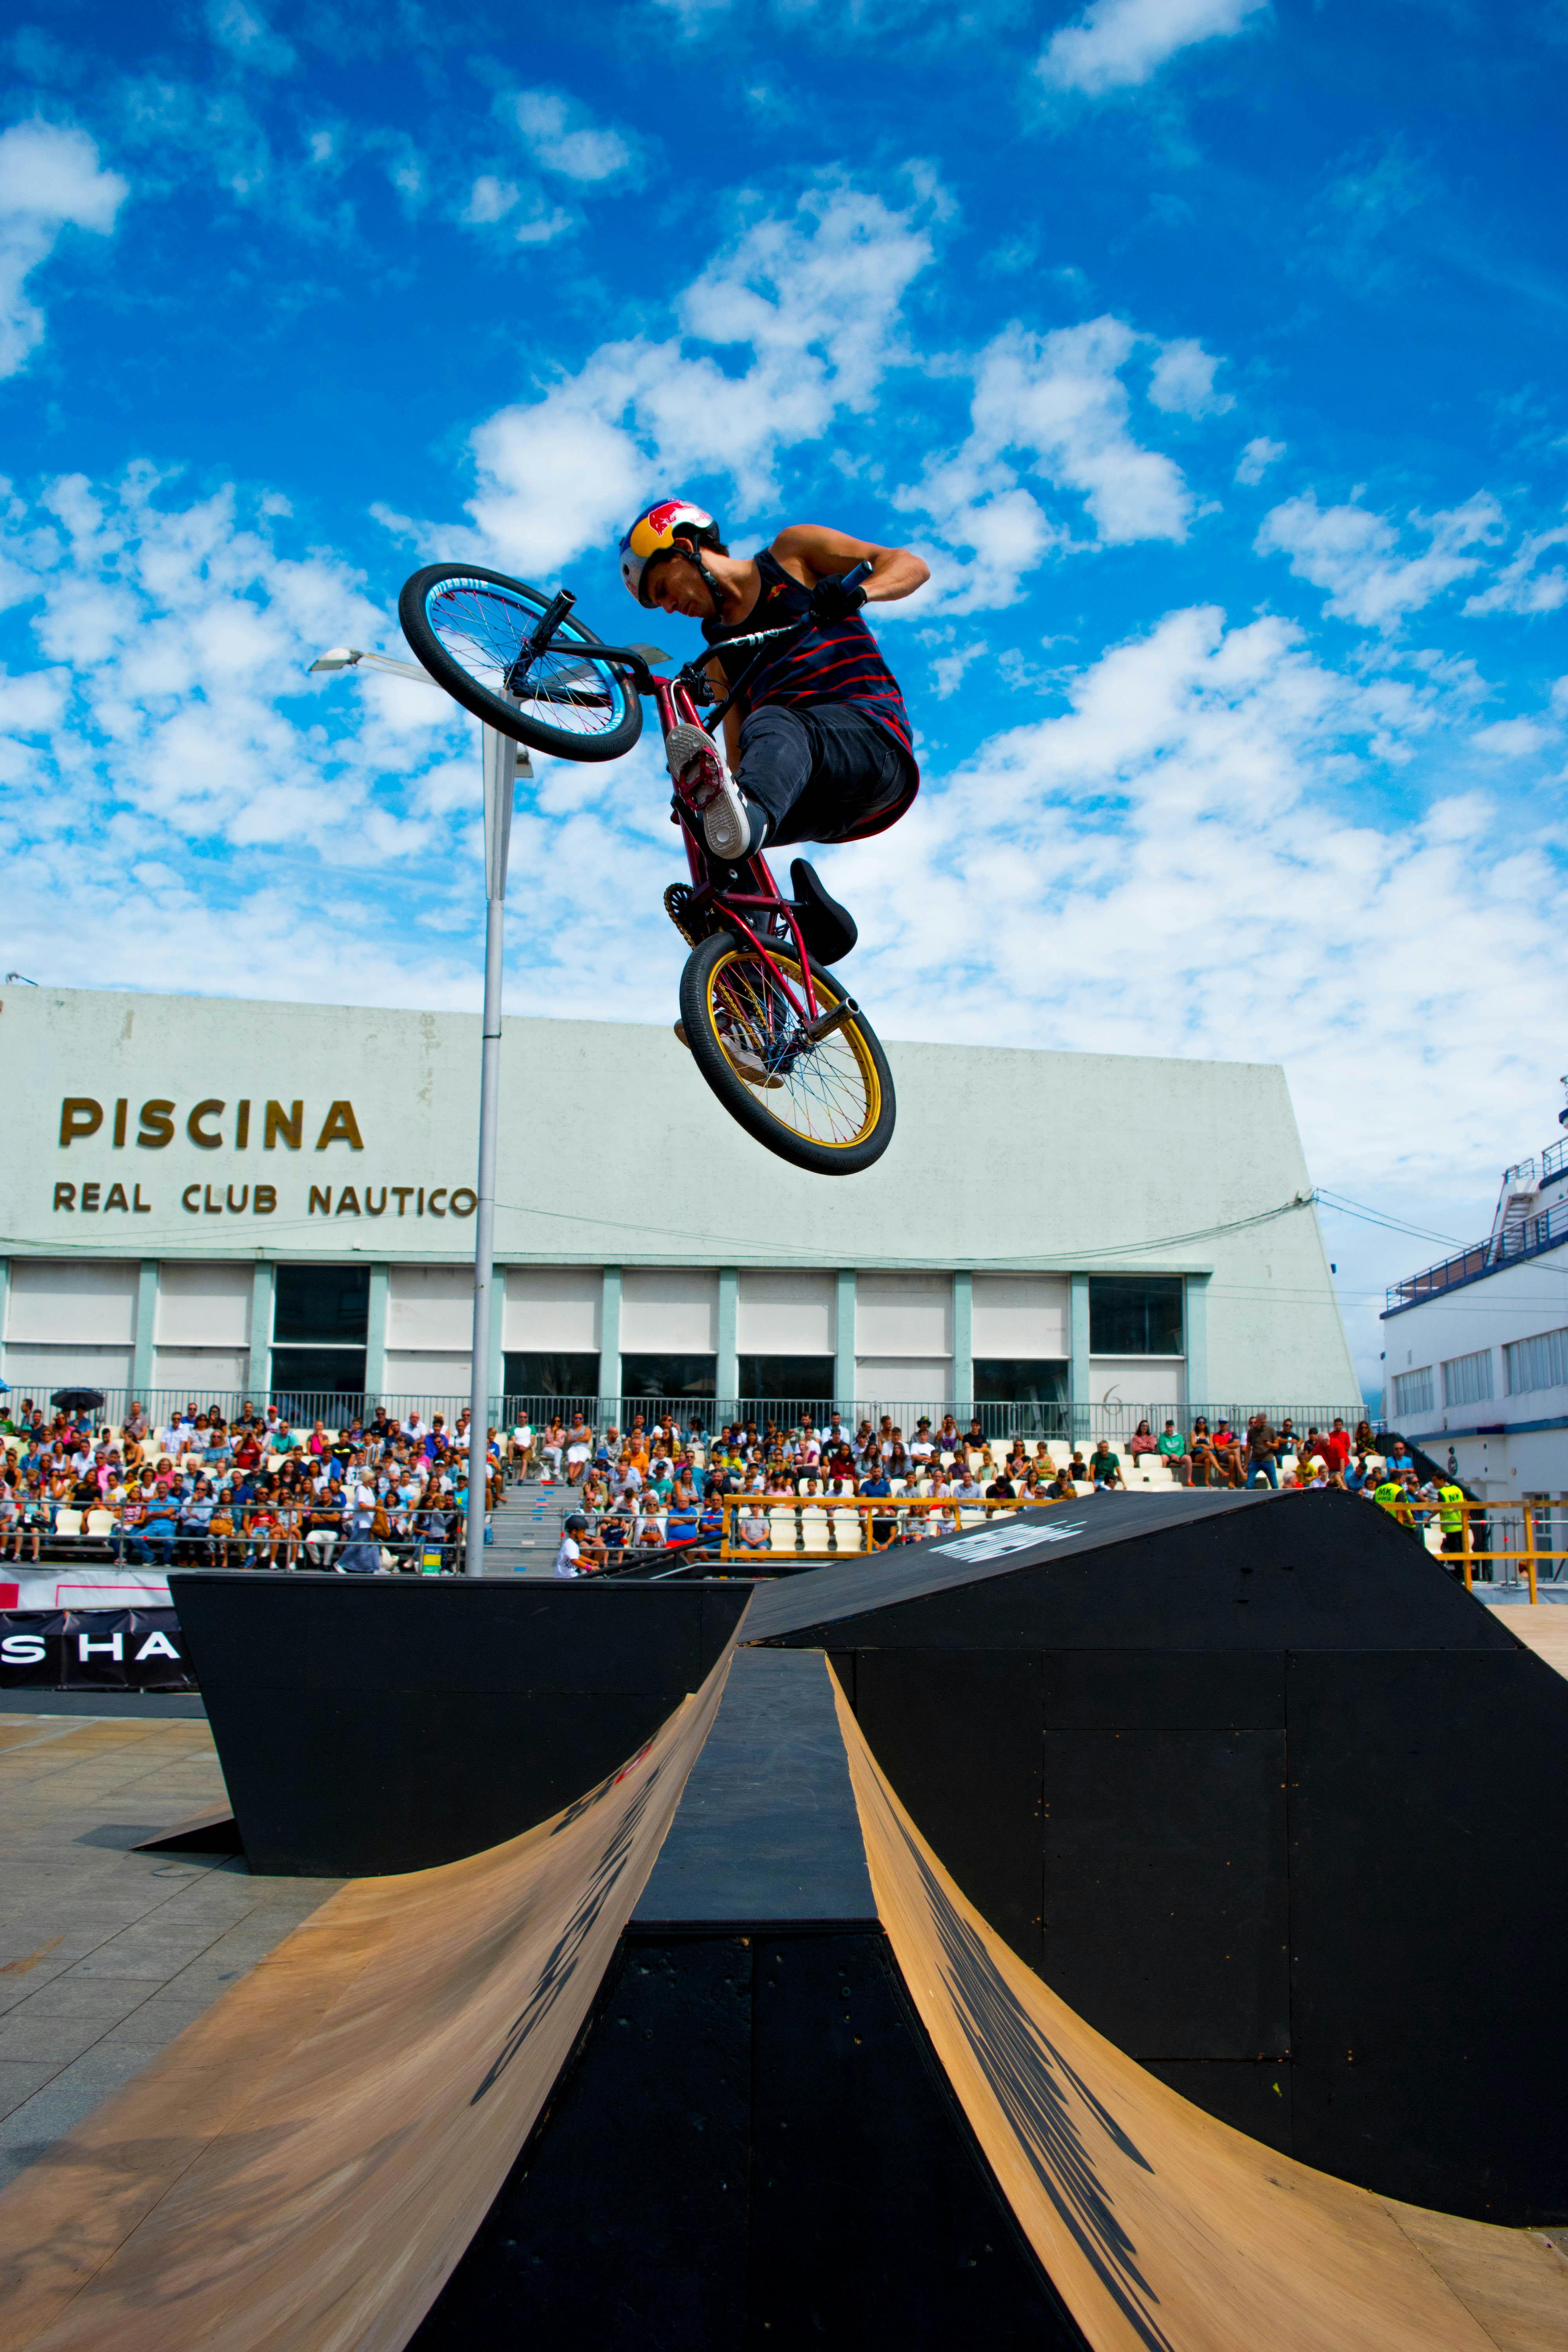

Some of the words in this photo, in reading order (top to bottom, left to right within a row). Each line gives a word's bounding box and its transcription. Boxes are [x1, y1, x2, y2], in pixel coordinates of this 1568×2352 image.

[60, 1098, 363, 1149] PISCINA
[54, 1181, 152, 1212] REAL
[182, 1184, 277, 1213] CLUB
[309, 1185, 477, 1218] NAUTICO
[1449, 1492, 1461, 1502] MK
[1, 1631, 181, 1664] SHA
